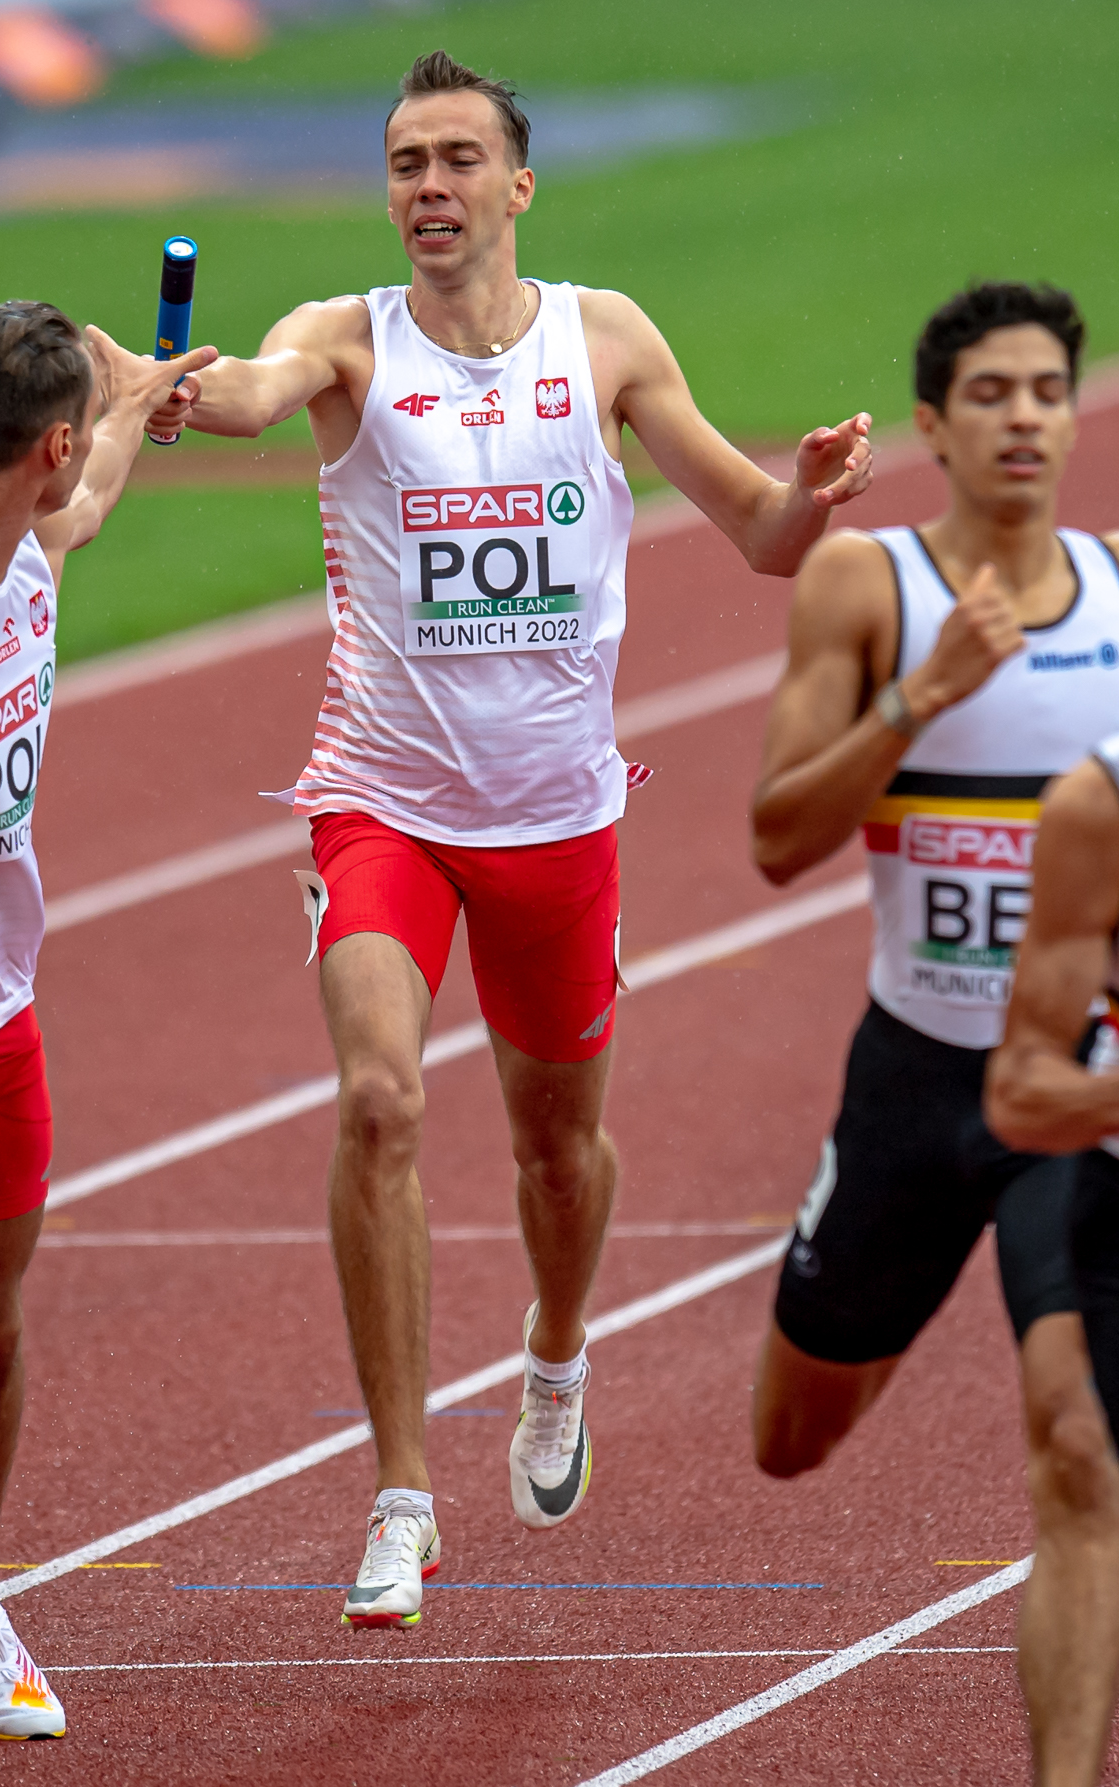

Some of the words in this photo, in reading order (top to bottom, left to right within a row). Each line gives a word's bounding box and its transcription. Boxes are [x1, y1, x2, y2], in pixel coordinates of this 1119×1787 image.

[392, 393, 441, 417] 4F
[406, 489, 540, 526] SPAR
[418, 537, 576, 603] POL
[458, 602, 492, 616] RUN
[417, 622, 517, 648] MUNICH
[526, 618, 580, 643] 2022
[0, 803, 22, 828] RUN
[927, 880, 1030, 949] BE
